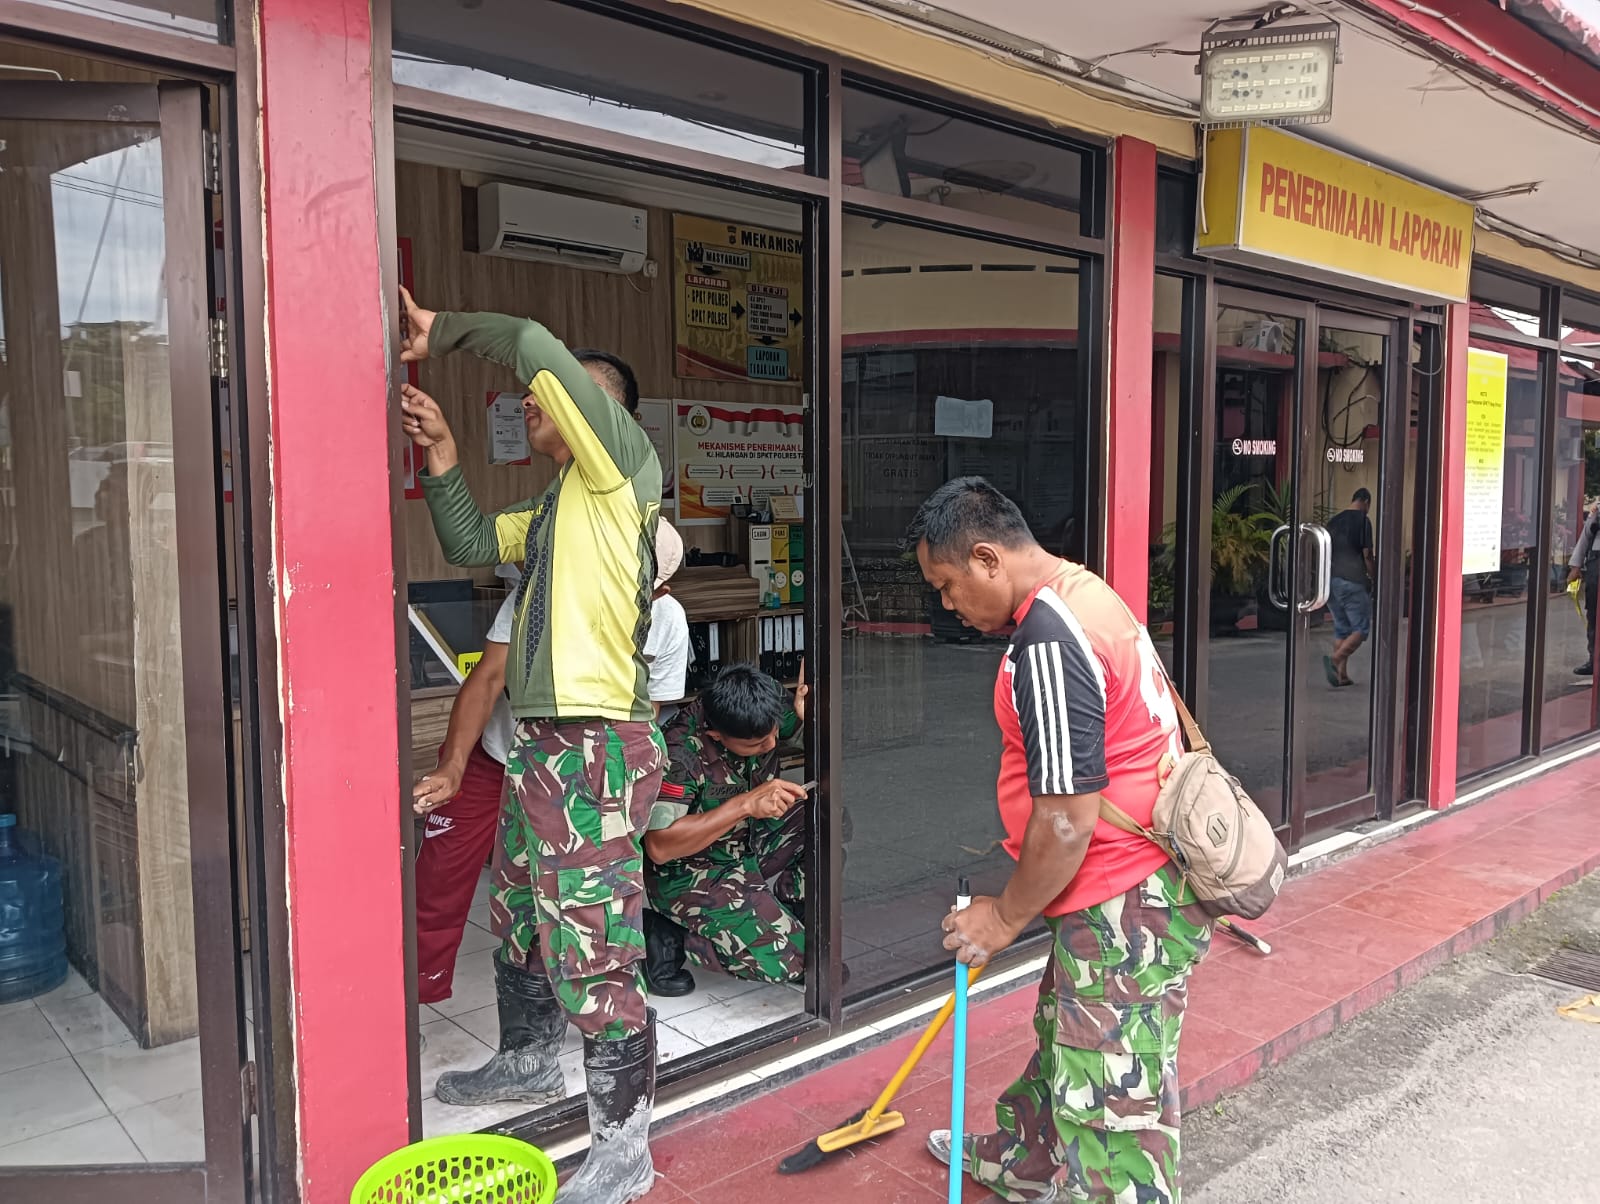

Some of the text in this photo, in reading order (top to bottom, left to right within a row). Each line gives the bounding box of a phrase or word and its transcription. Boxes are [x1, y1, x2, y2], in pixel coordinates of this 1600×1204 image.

[1260, 162, 1463, 269] PENERIMAAN LAPORAN
[706, 251, 748, 267] MASYARAKAT
[687, 275, 728, 288] LAPORAN
[692, 289, 728, 307] SPKT POLRES
[691, 309, 728, 326] SPKT POLSEK
[755, 350, 780, 362] LAPORAN
[750, 363, 786, 377] TIDAK LAYAK
[698, 442, 747, 451] MEKANISME
[747, 442, 796, 452] PENERIMAAN
[1243, 440, 1277, 455] NO SMOKING
[774, 452, 798, 460] POLRES
[1335, 448, 1364, 463] NO SMOKING
[883, 468, 920, 479] GRATIS
[428, 813, 453, 828] NIKE
